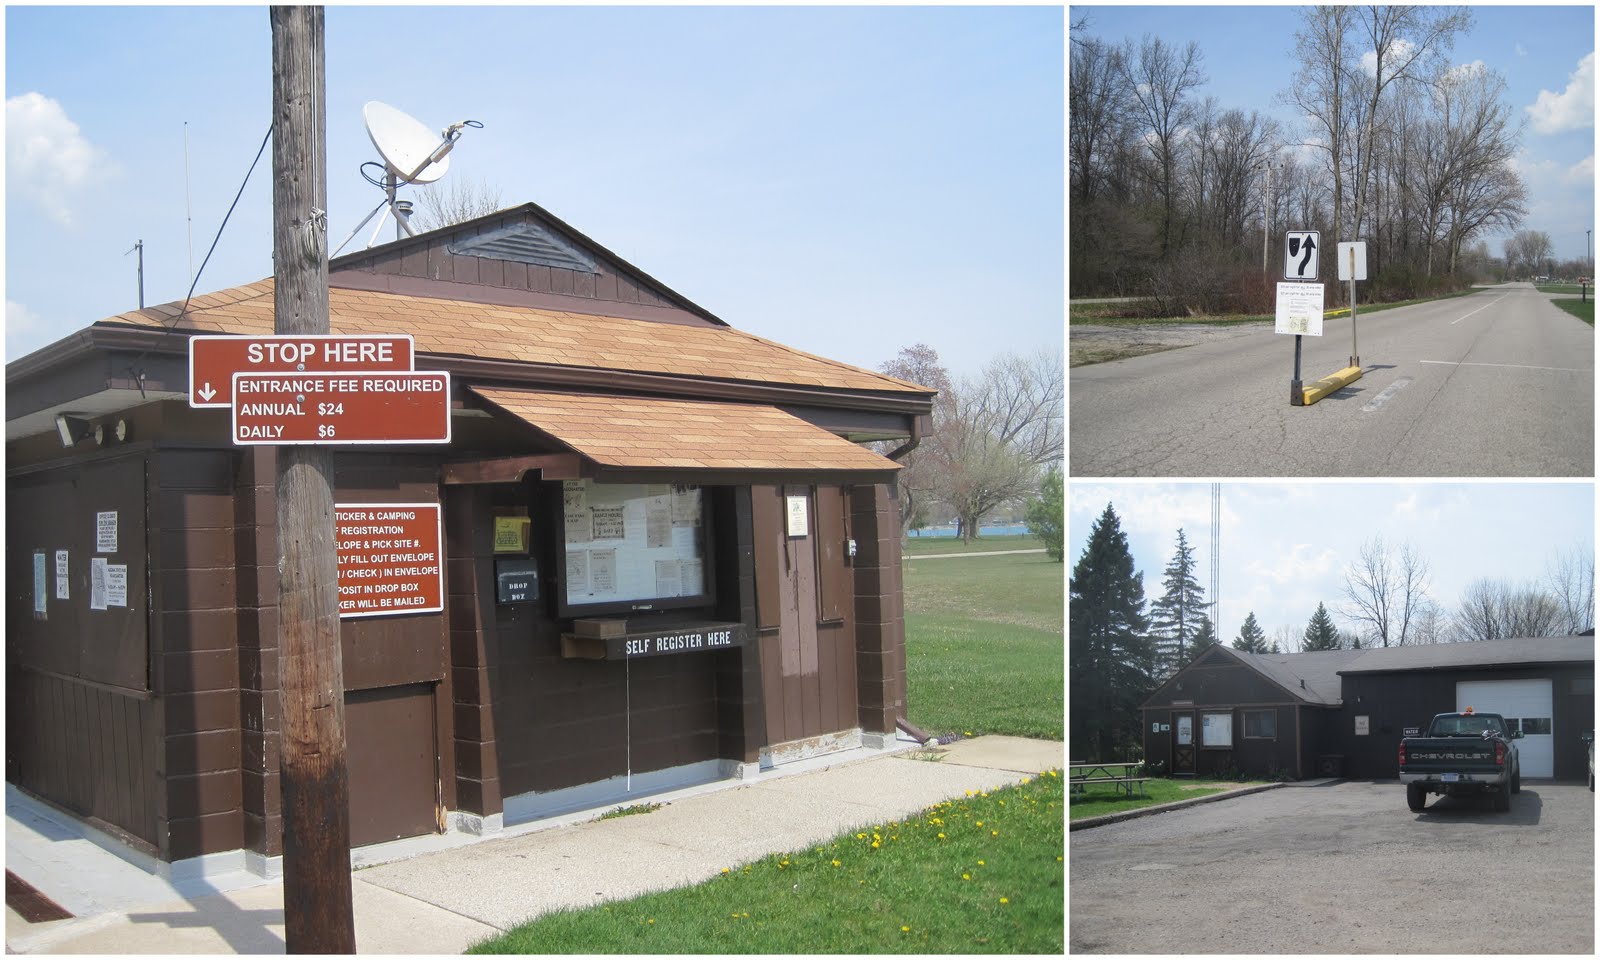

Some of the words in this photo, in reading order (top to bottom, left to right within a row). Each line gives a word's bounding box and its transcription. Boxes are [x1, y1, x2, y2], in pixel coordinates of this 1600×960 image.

[248, 343, 316, 363] STOP
[324, 342, 393, 362] HERE
[239, 380, 324, 393] ENTRANCE
[329, 380, 358, 392] FEE
[363, 380, 443, 392] REQUIRED
[240, 403, 305, 416] ANNUAL
[318, 402, 344, 416] $24
[240, 425, 284, 438] DAILY
[318, 425, 336, 438] $6
[369, 512, 375, 520] &
[377, 512, 415, 520] CAMPING
[341, 526, 404, 535] REGISTRATION
[364, 541, 370, 549] &
[372, 541, 392, 549] PICK
[394, 540, 412, 548] SITE
[351, 555, 368, 563] FILL
[391, 553, 434, 562] ENVELOPE
[347, 569, 377, 578] CHECK
[395, 567, 438, 576] ENVELOPE
[364, 585, 373, 593] IN
[375, 585, 398, 593] DROP
[401, 583, 418, 591] BOX
[358, 600, 378, 608] WILL
[381, 599, 392, 607] BE
[394, 597, 425, 606] MAILED
[626, 639, 650, 654] SELF
[656, 634, 702, 651] REGISTER
[707, 631, 731, 646] HERE
